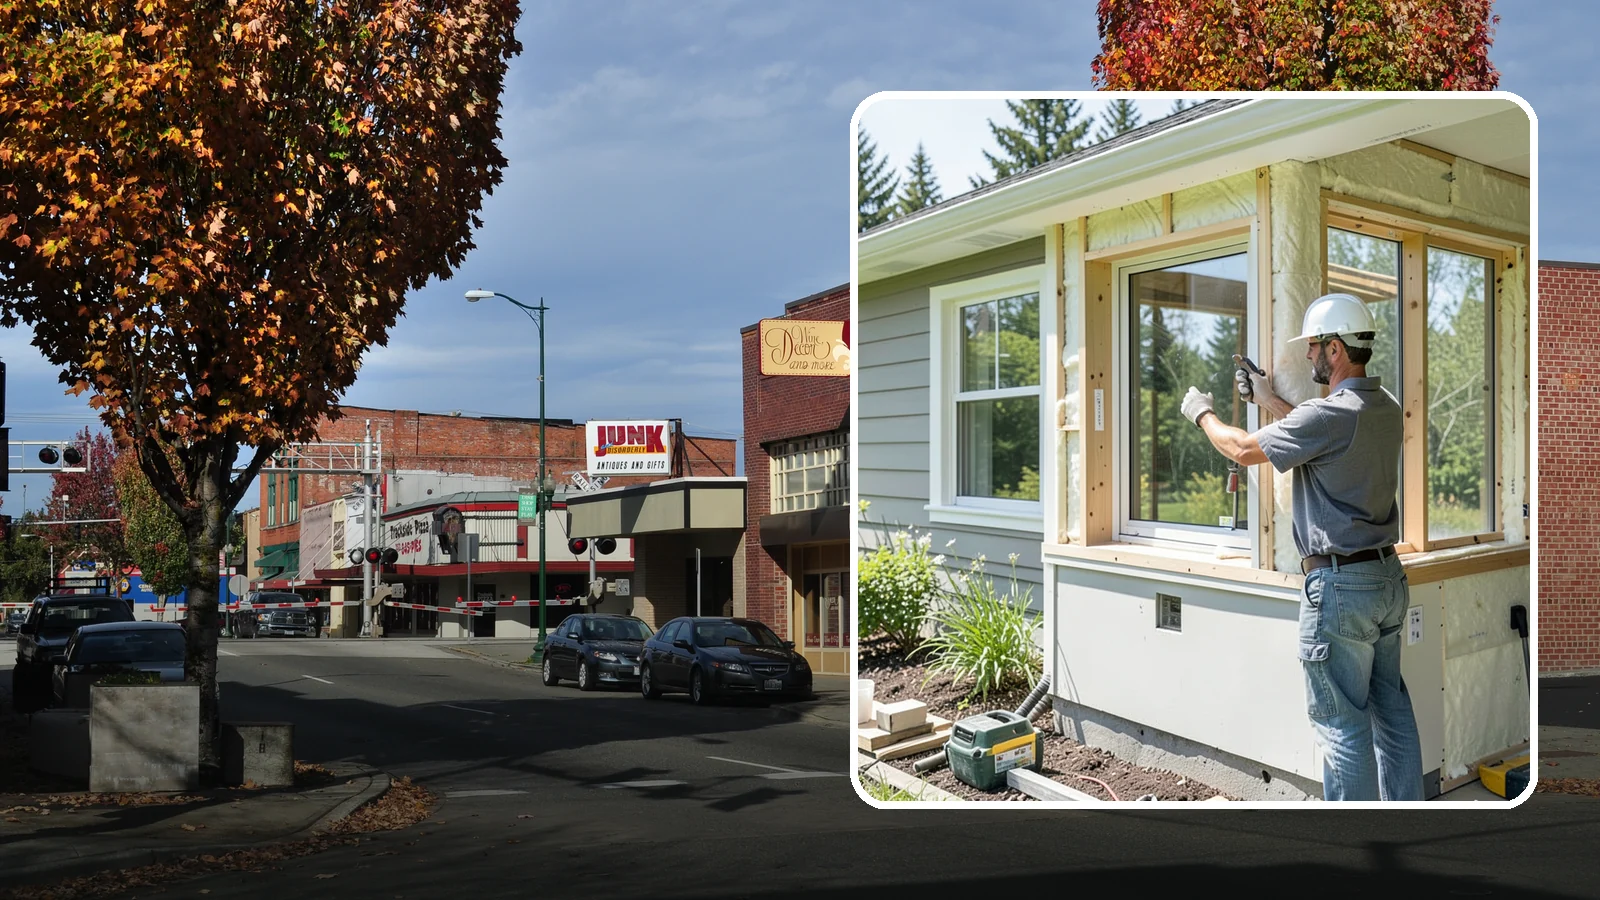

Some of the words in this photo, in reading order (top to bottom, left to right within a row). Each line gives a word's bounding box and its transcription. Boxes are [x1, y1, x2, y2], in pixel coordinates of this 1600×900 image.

[595, 425, 664, 457] JUNK
[607, 446, 646, 454] DISORDERLY
[597, 461, 628, 470] ANTIQUES
[631, 461, 644, 470] AND
[647, 460, 665, 469] GIFTS
[414, 519, 429, 535] Pizza
